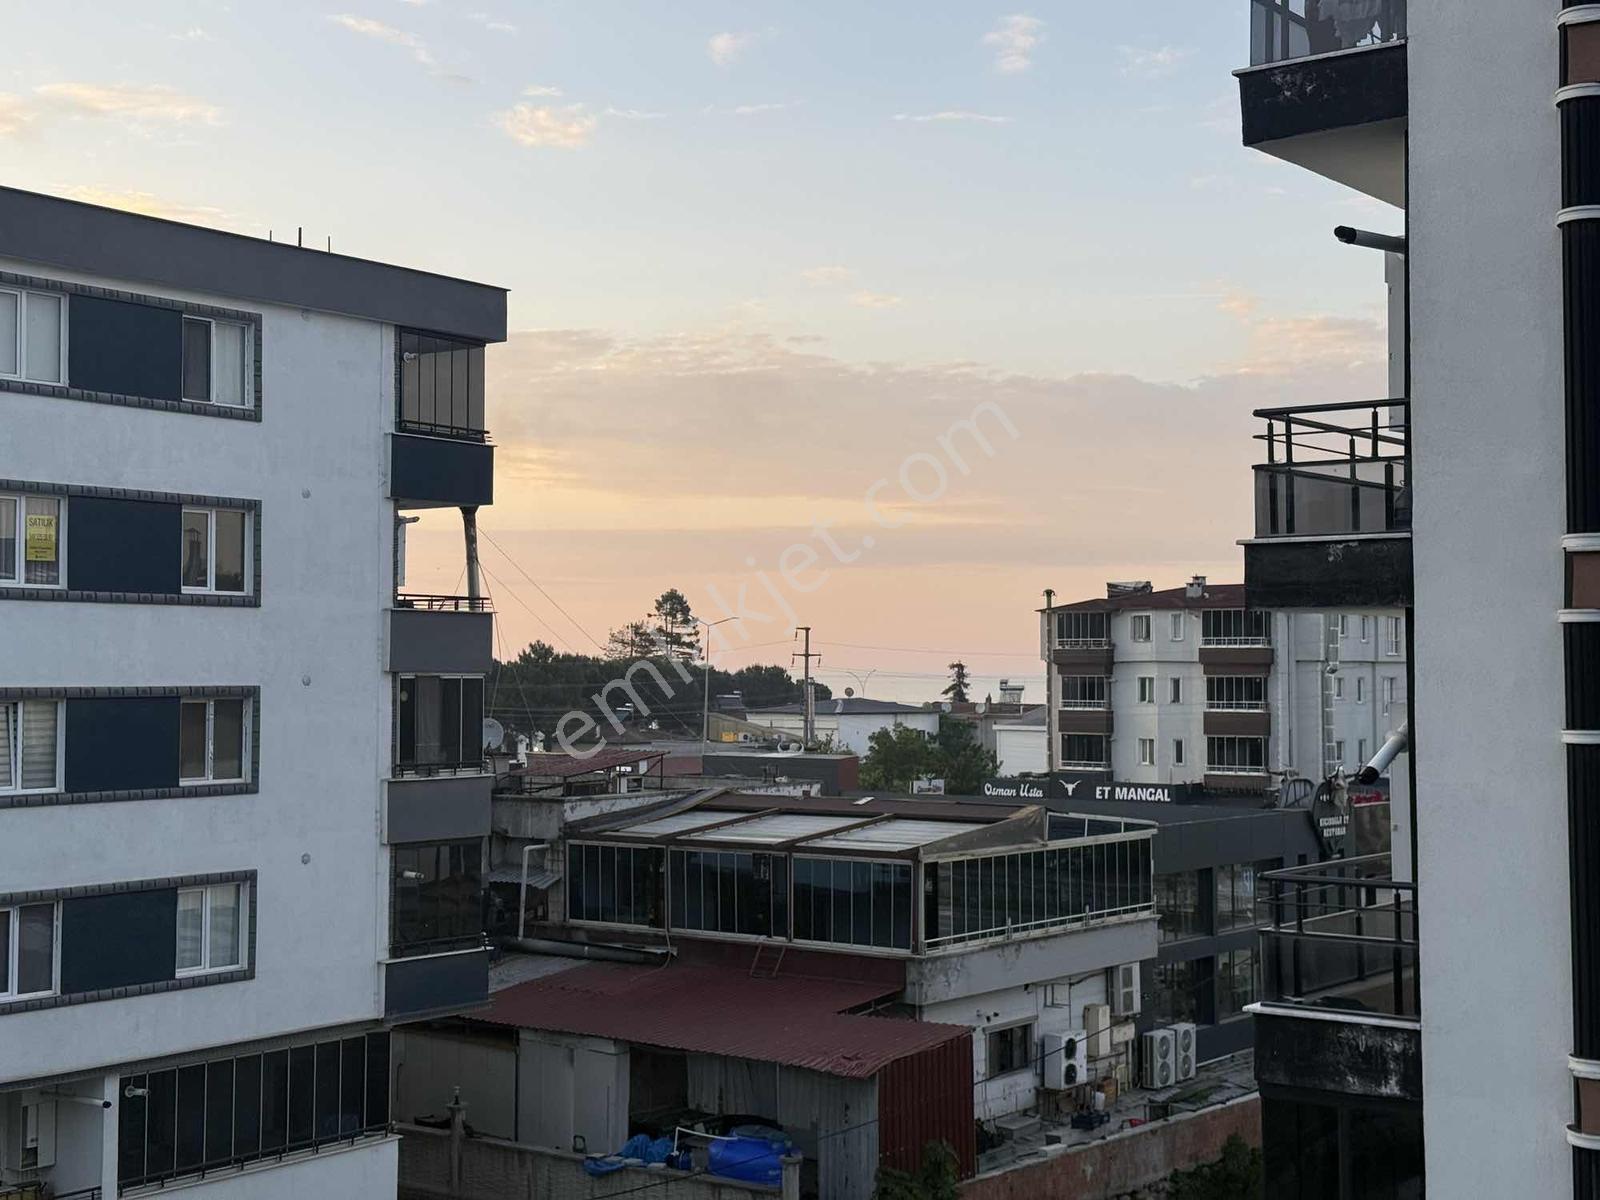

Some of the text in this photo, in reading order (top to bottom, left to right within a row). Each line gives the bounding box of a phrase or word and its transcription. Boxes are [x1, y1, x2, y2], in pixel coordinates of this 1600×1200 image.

[29, 517, 54, 527] SATILIK
[984, 782, 1044, 798] Osman Usta
[1095, 786, 1171, 802] ET MANGAL
